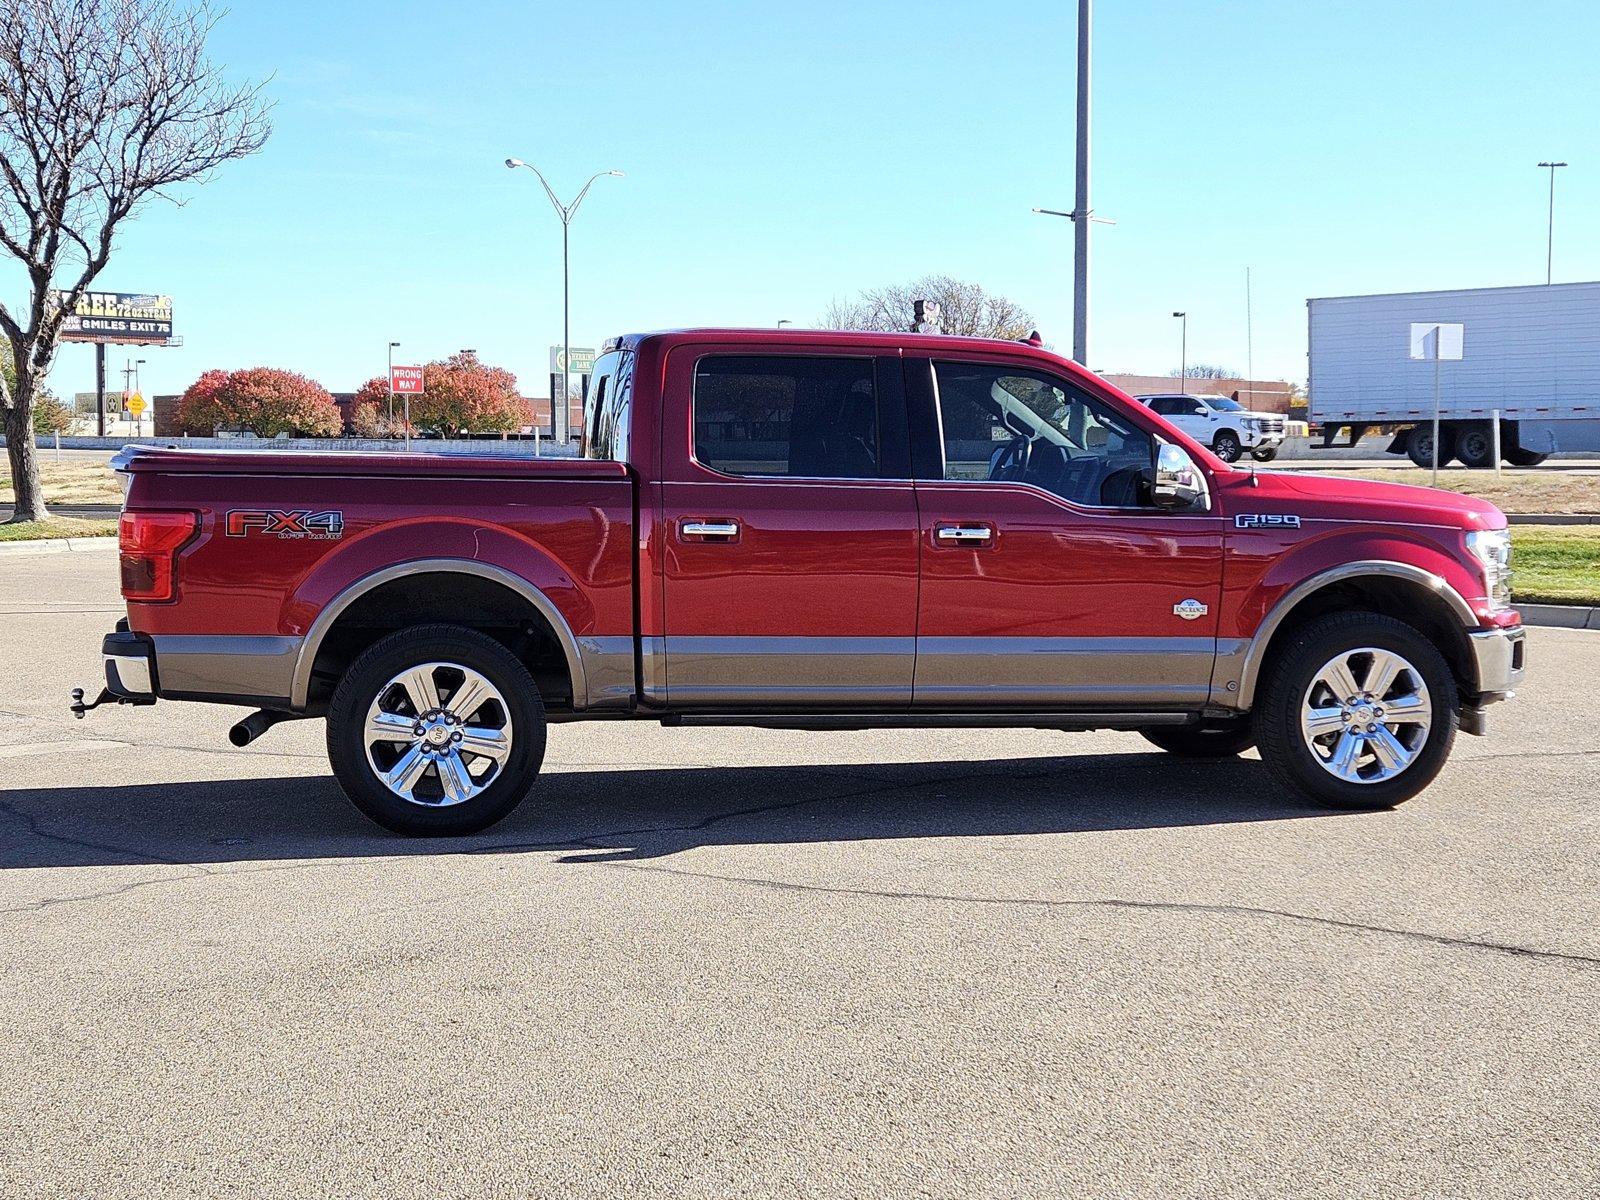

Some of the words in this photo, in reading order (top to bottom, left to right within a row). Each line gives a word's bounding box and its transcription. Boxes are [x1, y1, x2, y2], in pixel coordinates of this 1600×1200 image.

[117, 304, 132, 317] 72
[82, 319, 90, 329] 8
[90, 320, 126, 330] MILES
[129, 322, 157, 332] EXIT
[157, 323, 170, 333] 75
[393, 369, 422, 379] WRONG
[399, 380, 416, 389] WAY
[226, 509, 343, 537] FX4
